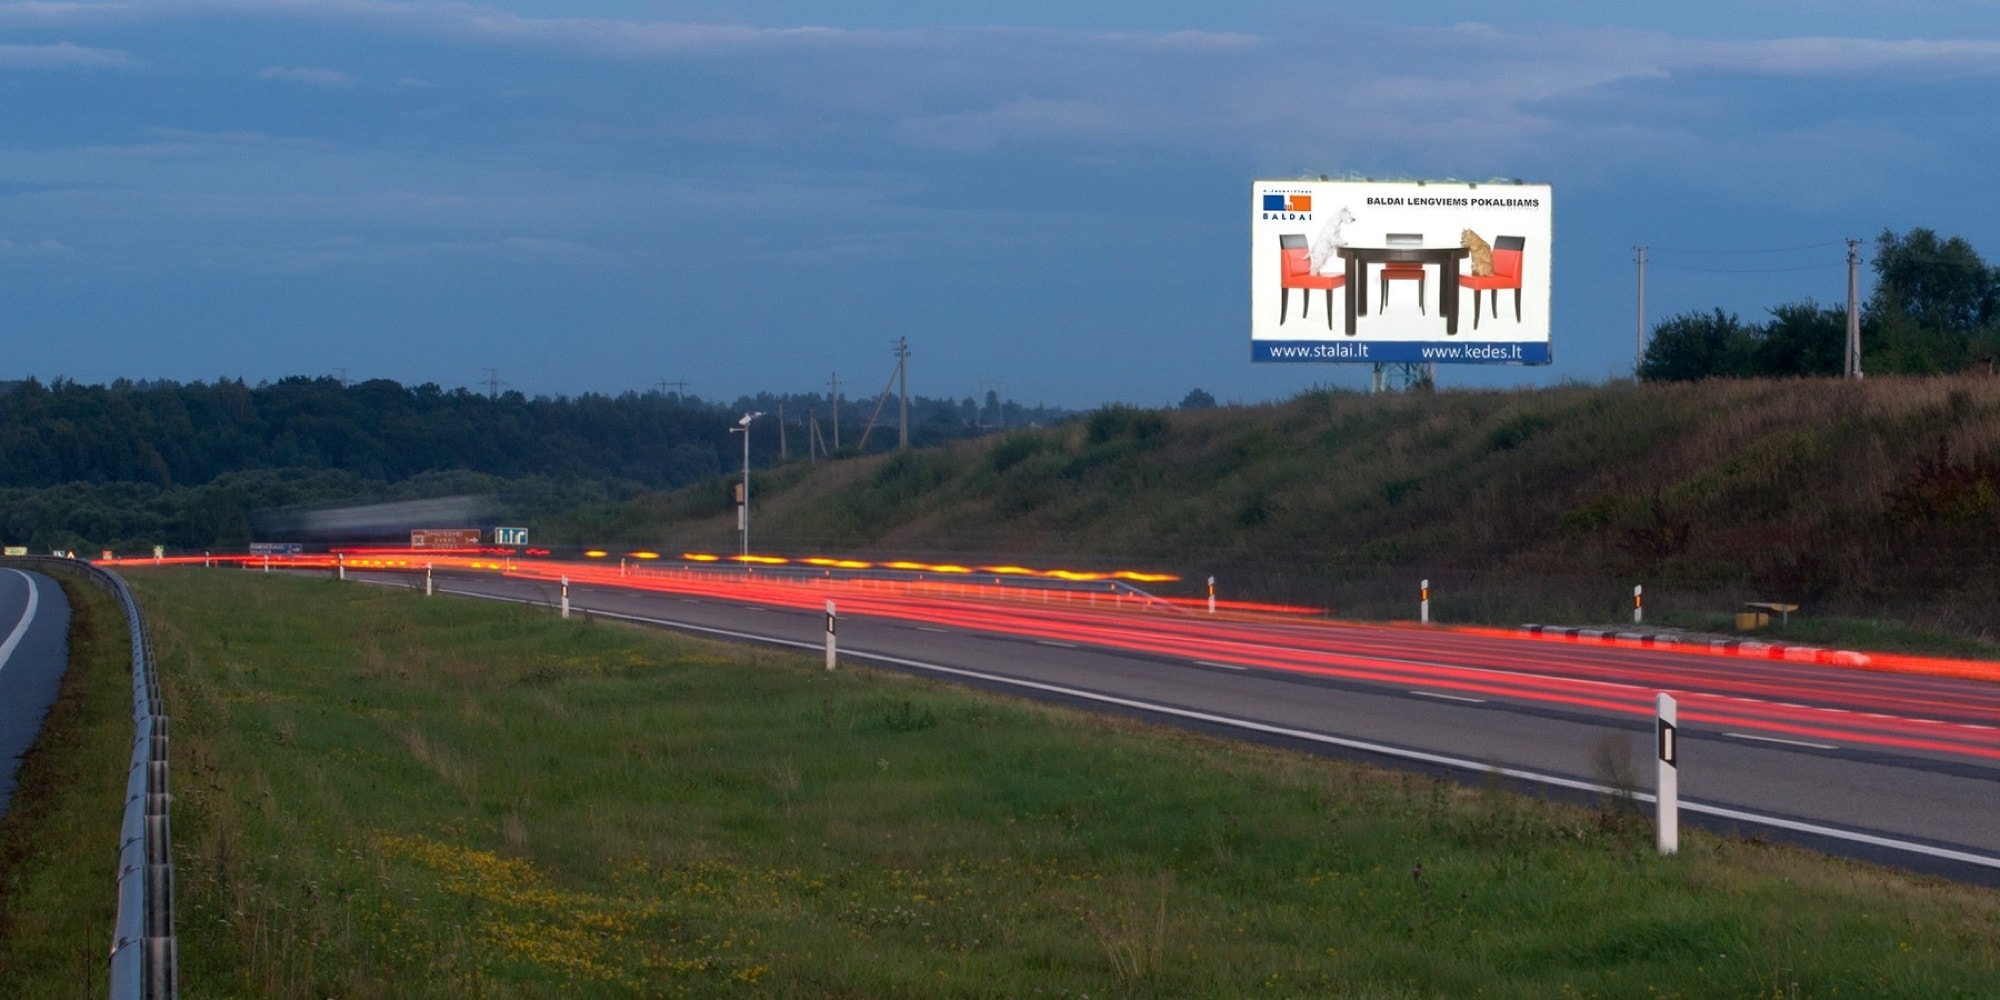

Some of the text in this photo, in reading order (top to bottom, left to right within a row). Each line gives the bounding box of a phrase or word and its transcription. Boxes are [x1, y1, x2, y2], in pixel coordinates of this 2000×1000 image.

[1366, 196, 1540, 208] BALDAI LENGVIEMS POKALBIAMS
[1262, 212, 1312, 221] BALDAI
[1269, 343, 1369, 358] www.stalai.lt
[1421, 344, 1522, 359] www.kedes.lt
